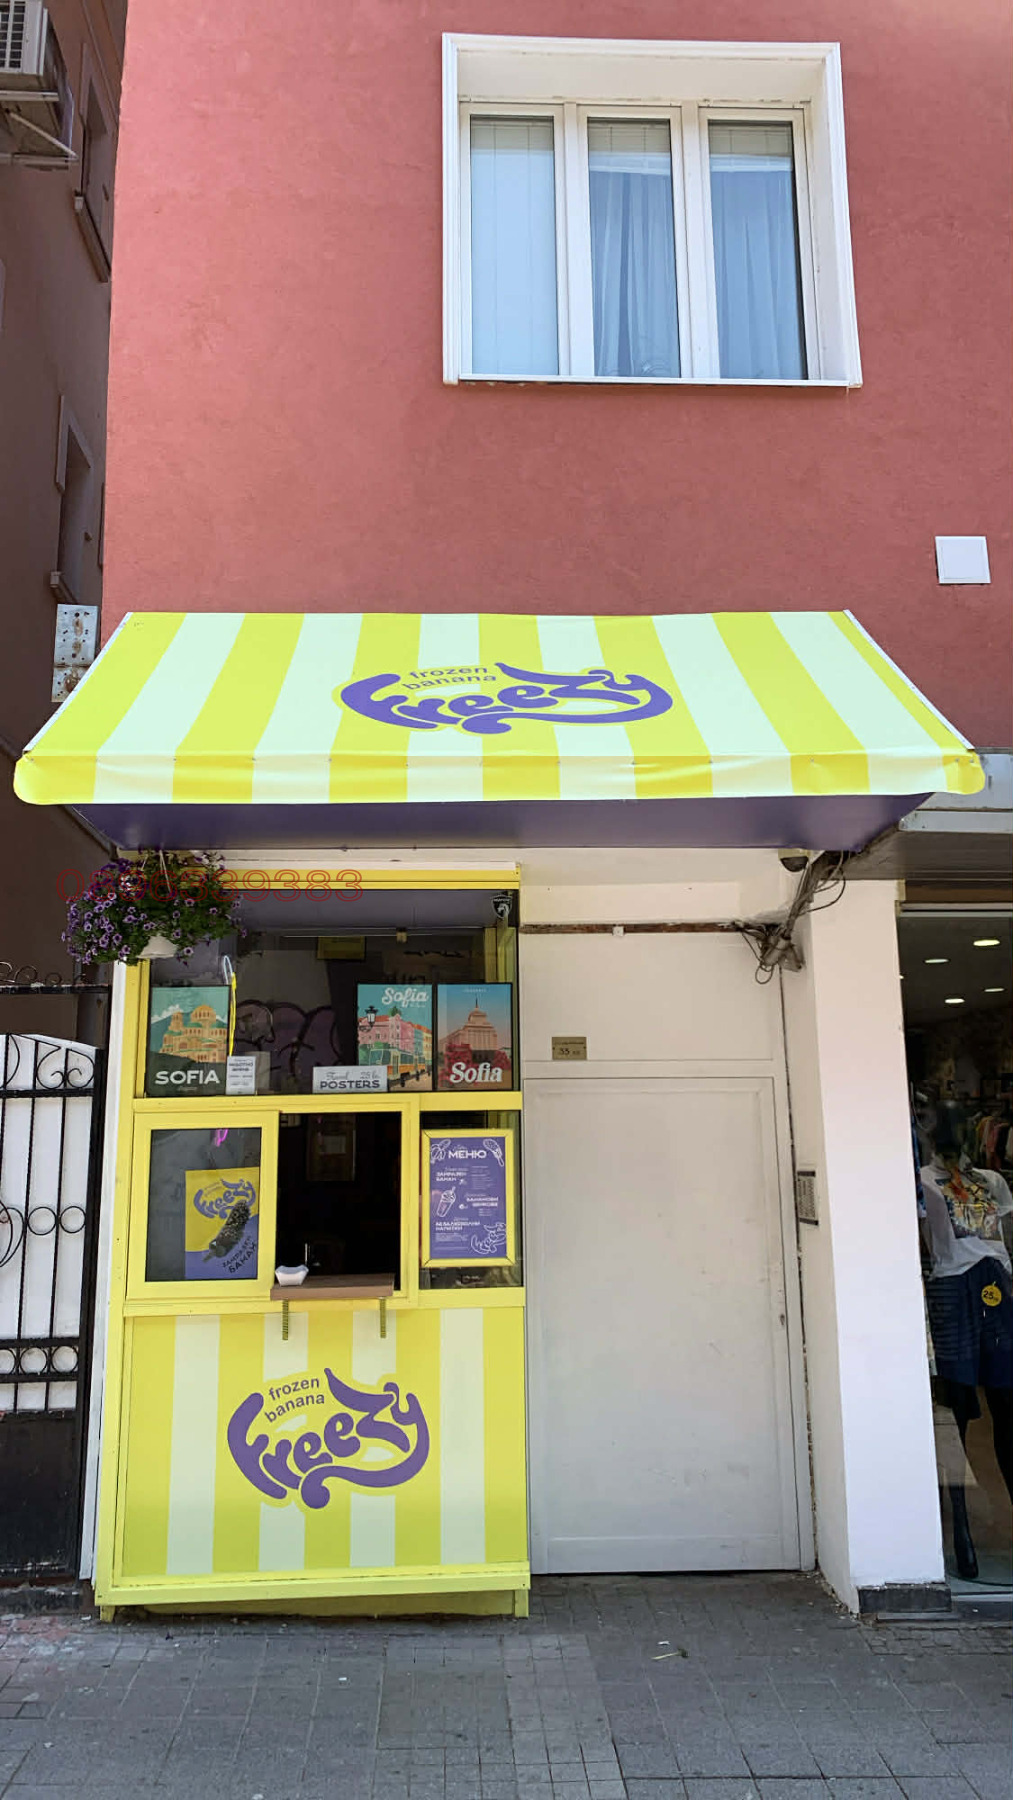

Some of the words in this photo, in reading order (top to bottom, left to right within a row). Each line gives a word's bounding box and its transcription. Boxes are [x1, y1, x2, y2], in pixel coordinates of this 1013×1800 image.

[409, 665, 489, 680] frozen
[402, 673, 497, 691] banana
[381, 986, 430, 1008] Sofia
[155, 1069, 220, 1085] SOFIA
[449, 1061, 503, 1084] Sofia
[319, 1079, 380, 1089] POSTERS
[448, 1149, 487, 1159] МЕНЮ
[268, 1377, 320, 1402] frozen
[264, 1391, 326, 1423] banana
